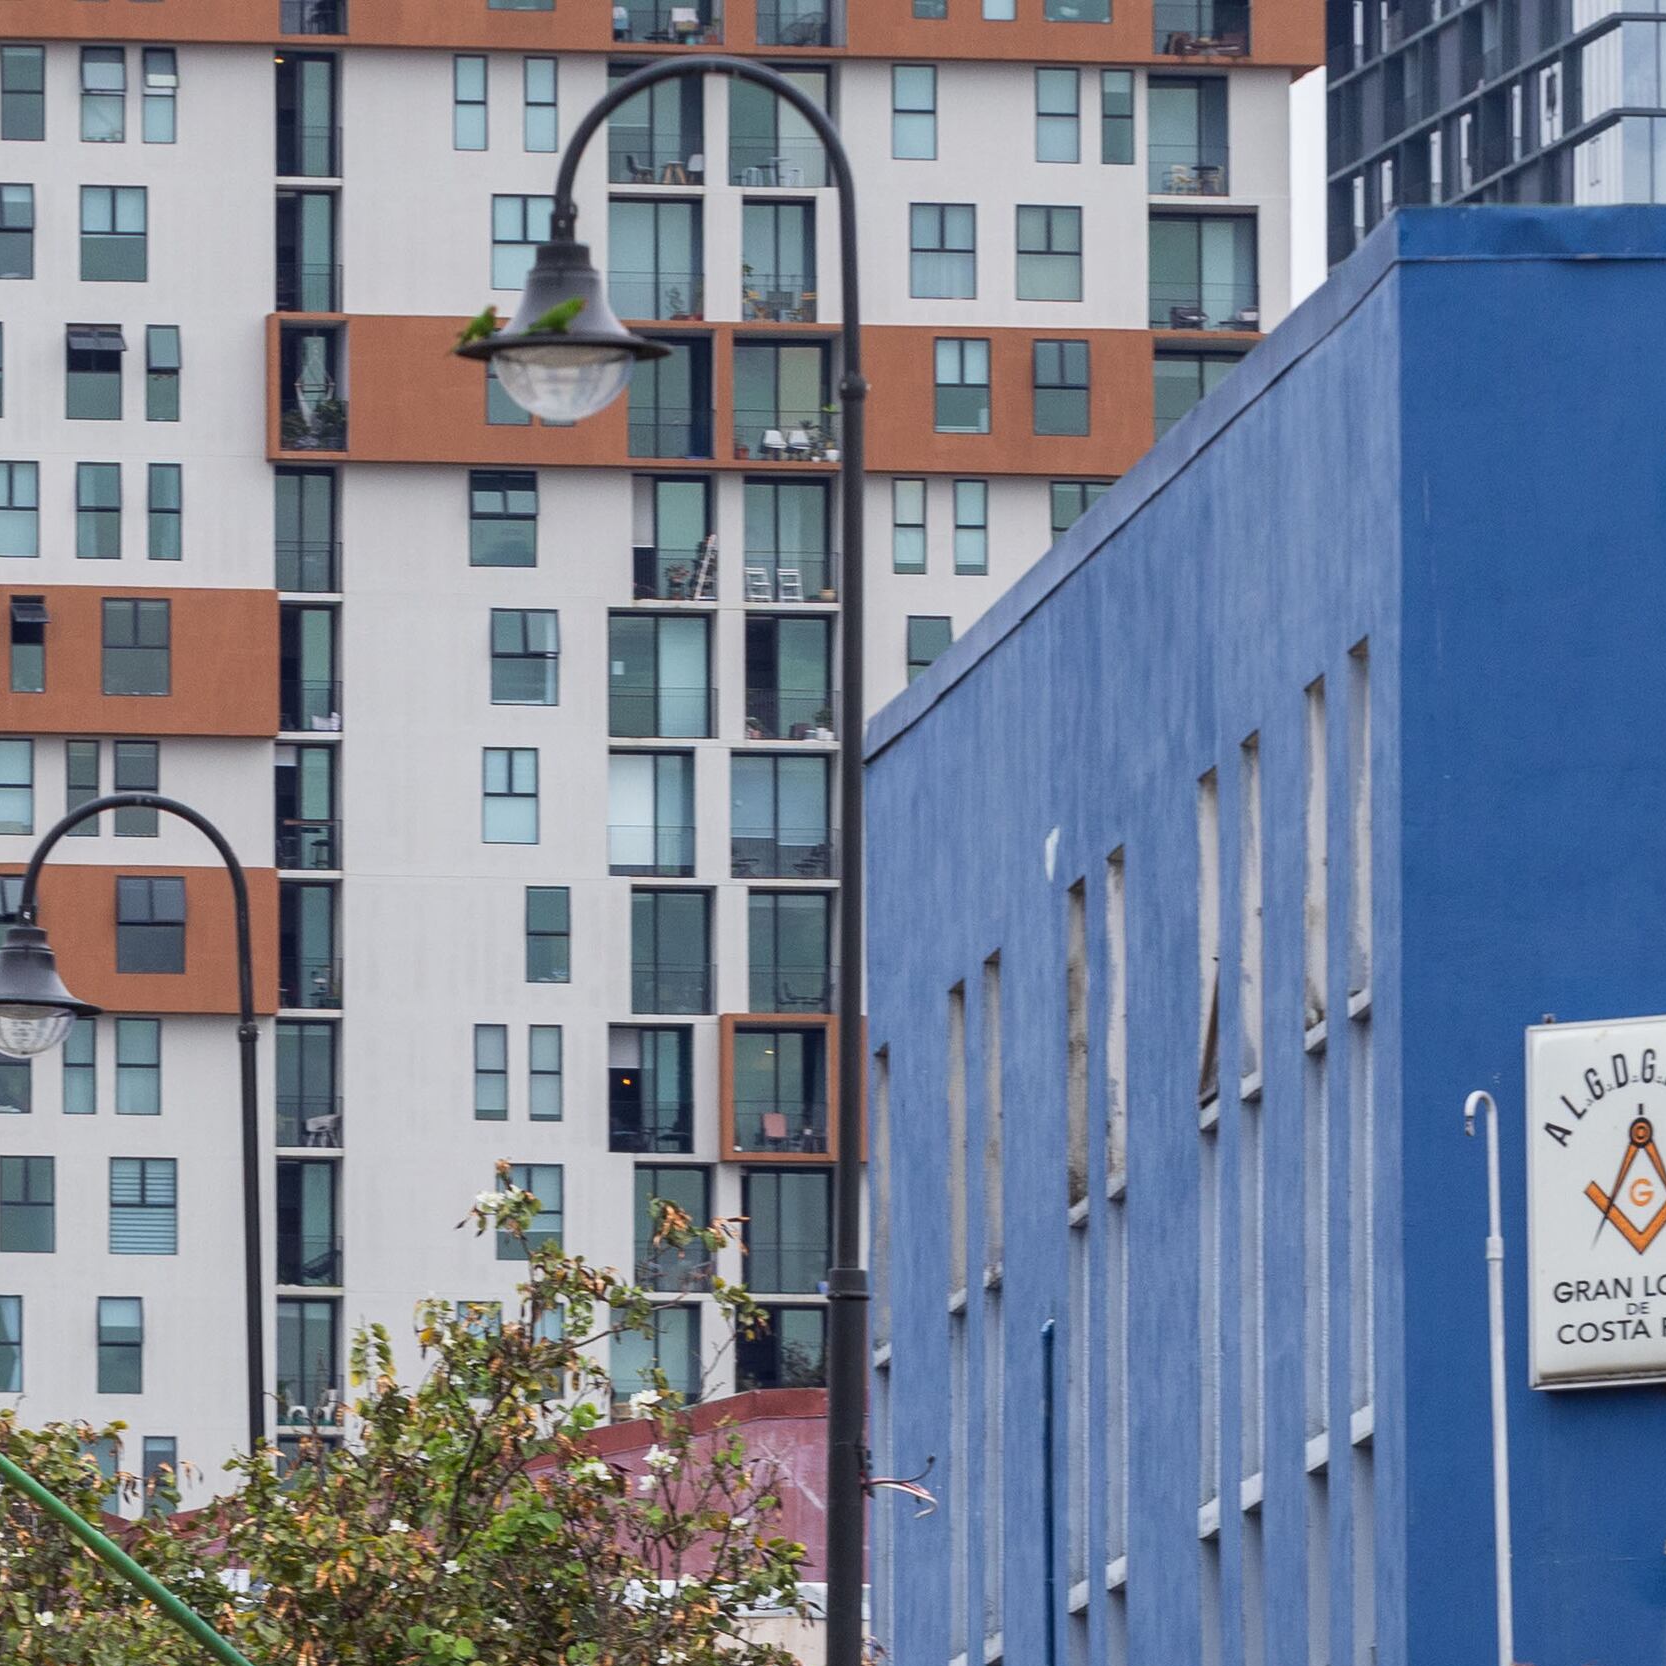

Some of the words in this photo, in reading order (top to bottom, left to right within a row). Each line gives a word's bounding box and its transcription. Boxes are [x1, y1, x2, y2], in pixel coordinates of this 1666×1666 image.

[1630, 1177, 1655, 1207] G
[1553, 1276, 1632, 1304] GRAN
[1626, 1301, 1651, 1316] DE
[1556, 1318, 1652, 1345] COSTA
